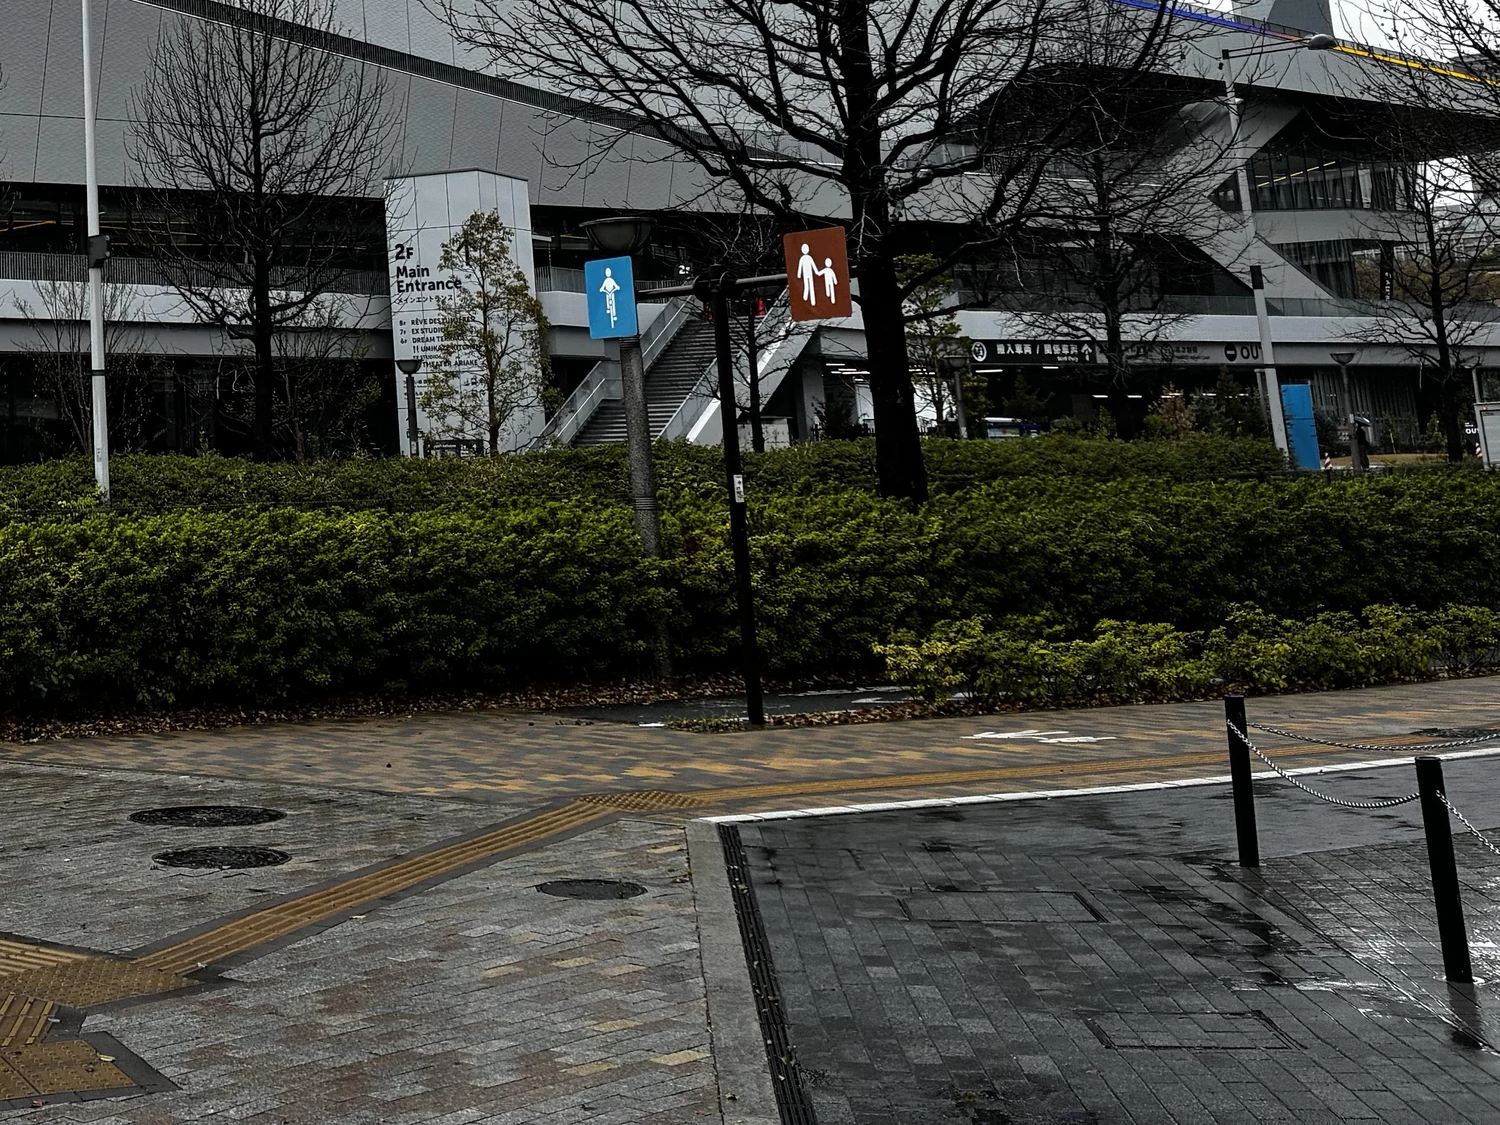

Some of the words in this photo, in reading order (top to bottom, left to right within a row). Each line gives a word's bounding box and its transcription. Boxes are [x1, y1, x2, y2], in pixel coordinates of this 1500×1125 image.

[395, 243, 414, 260] 2F
[396, 265, 430, 279] Main
[397, 279, 462, 293] Entrance
[1240, 346, 1262, 360] OU
